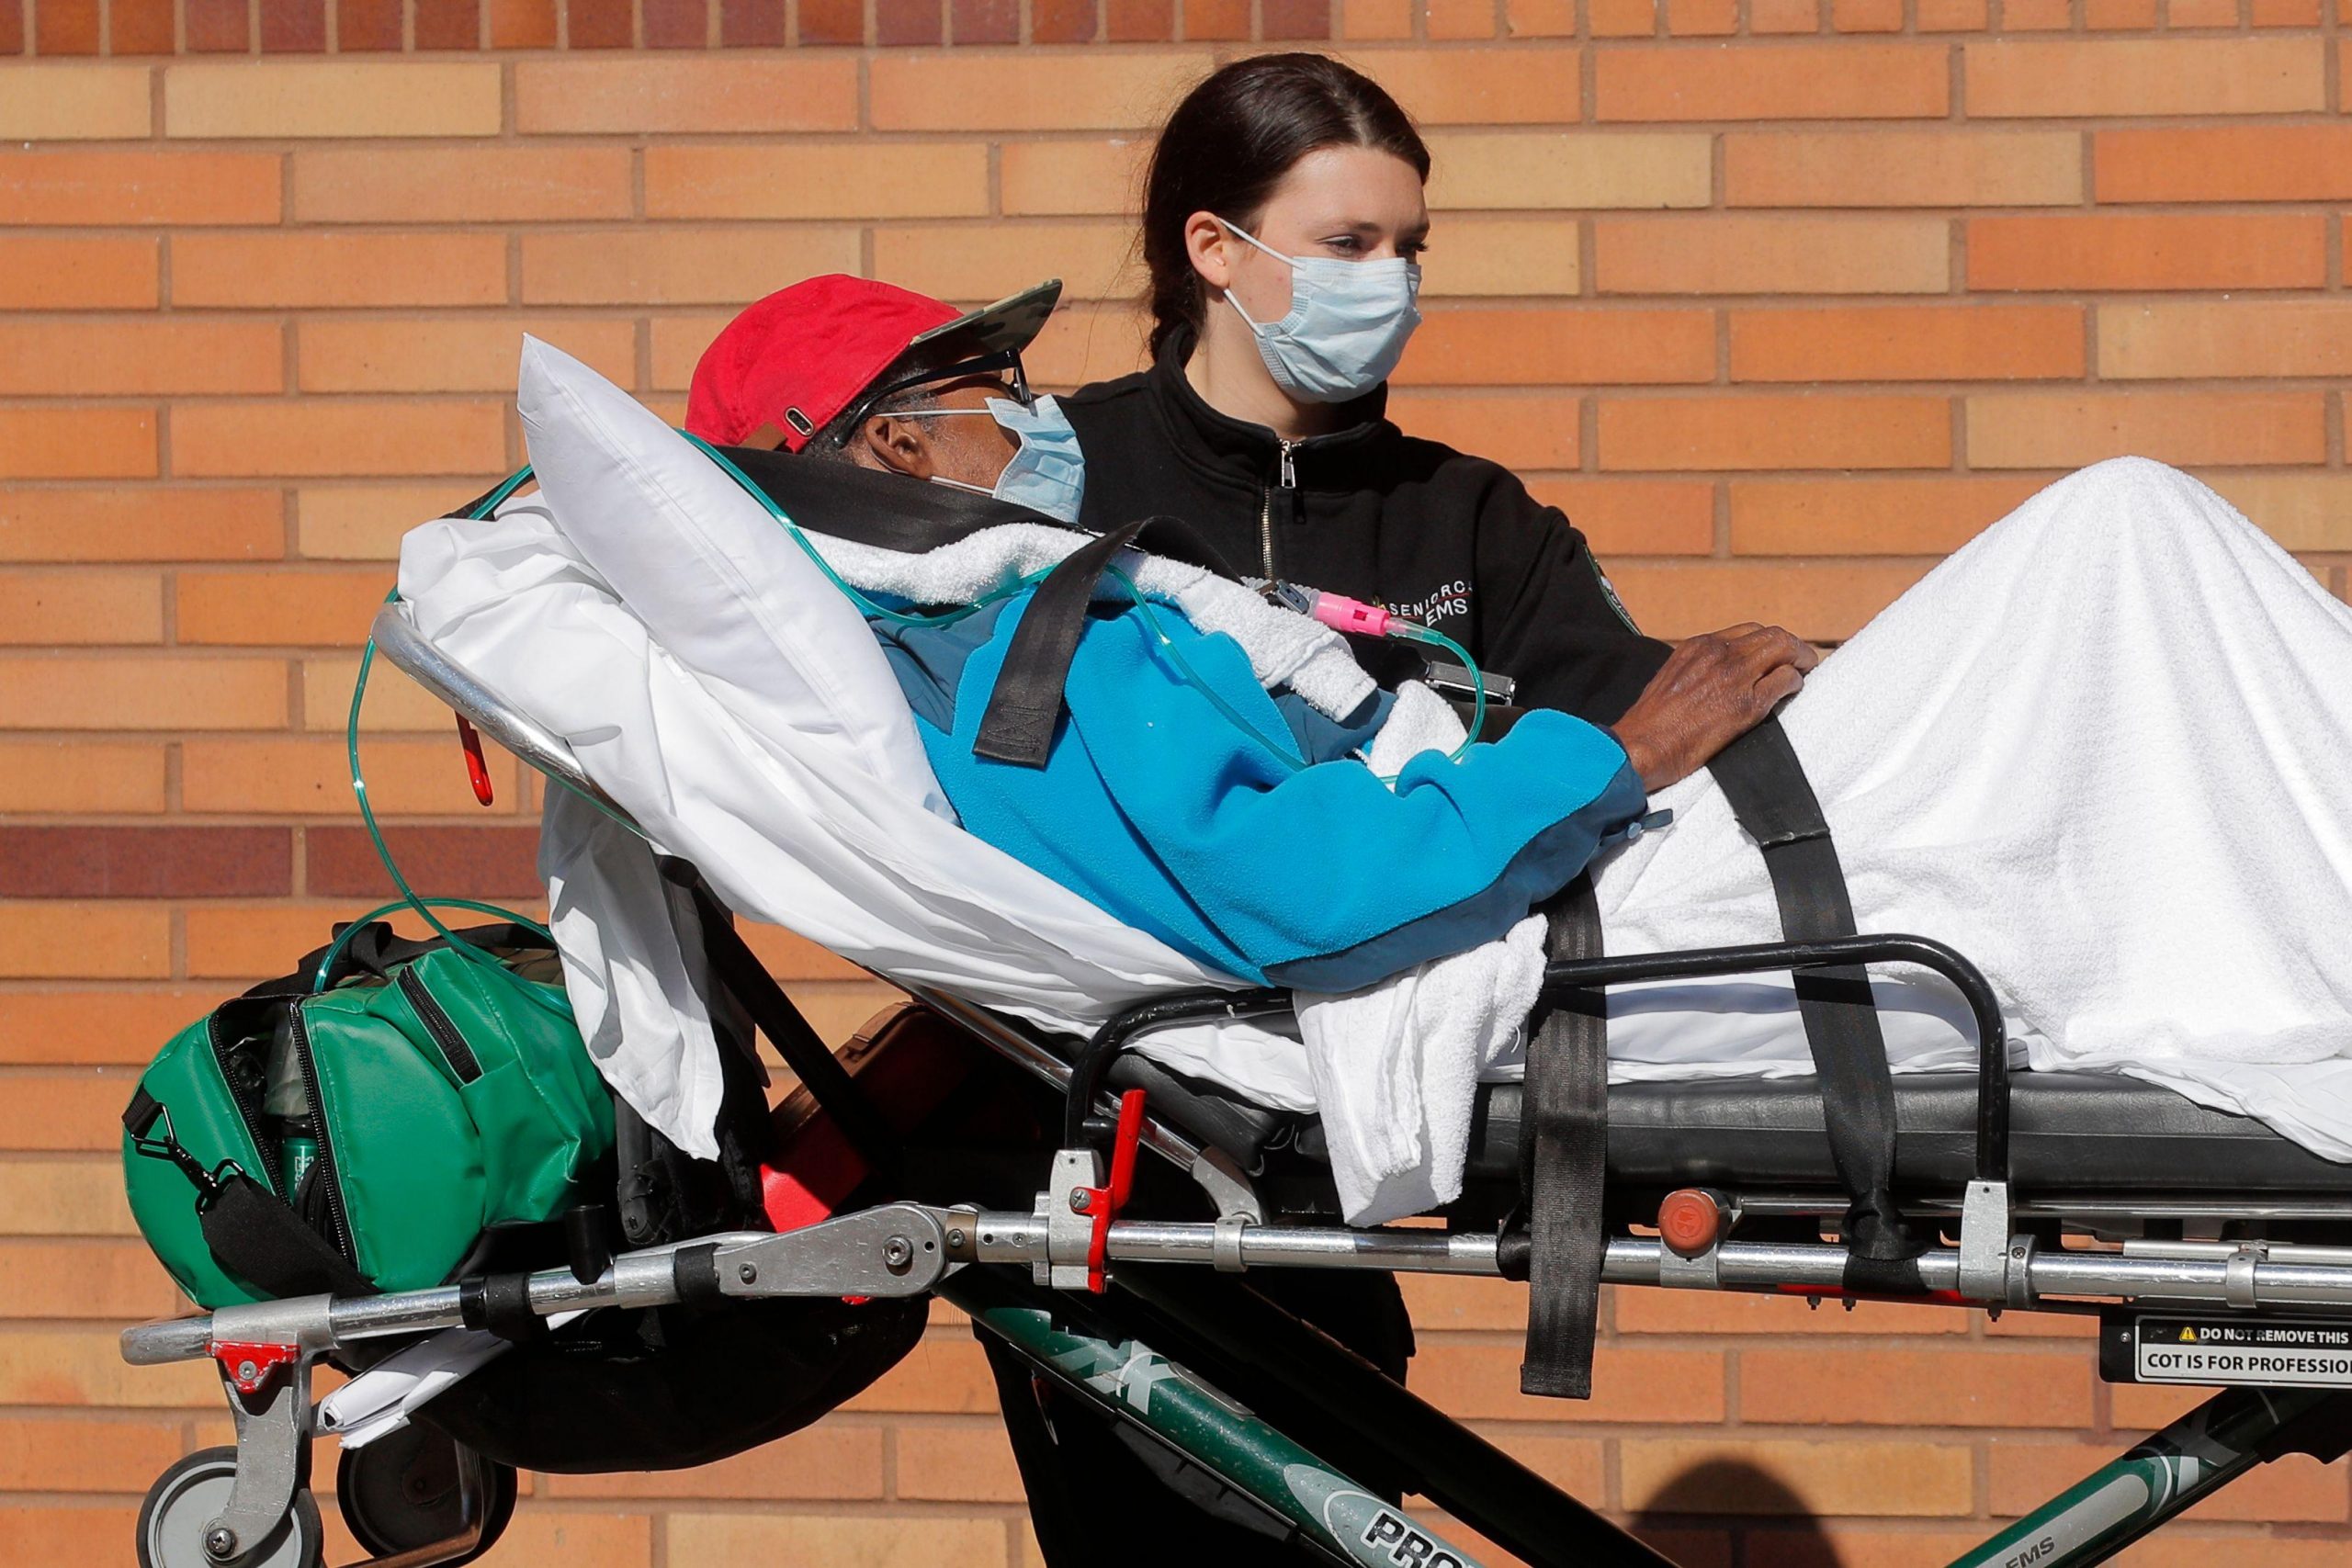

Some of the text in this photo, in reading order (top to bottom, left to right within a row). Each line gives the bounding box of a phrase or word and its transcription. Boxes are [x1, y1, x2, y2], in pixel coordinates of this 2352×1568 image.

[1389, 580, 1473, 616] SENIORC
[1426, 598, 1468, 626] EMS
[2199, 1327, 2349, 1344] DO NOT REMOVE THIS
[2148, 1353, 2352, 1374] COT IS FOR PROFESSIO
